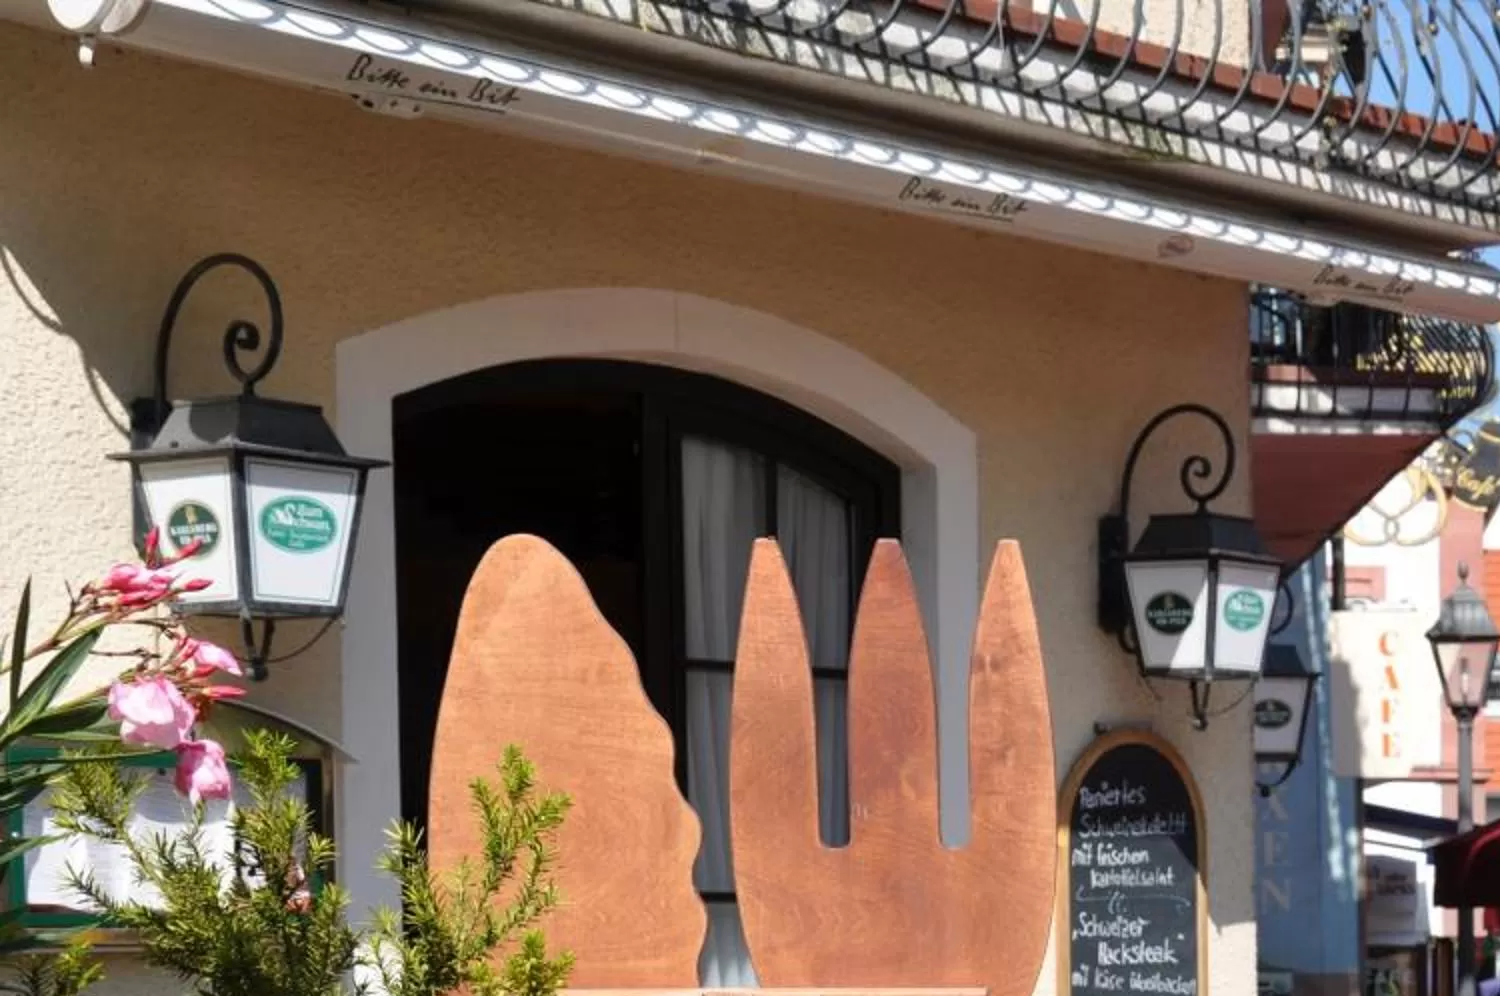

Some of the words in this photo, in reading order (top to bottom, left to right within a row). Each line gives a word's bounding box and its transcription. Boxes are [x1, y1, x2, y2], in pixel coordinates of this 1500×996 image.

[346, 53, 410, 88] Bitte
[418, 79, 457, 98] ein
[468, 77, 521, 106] Bit
